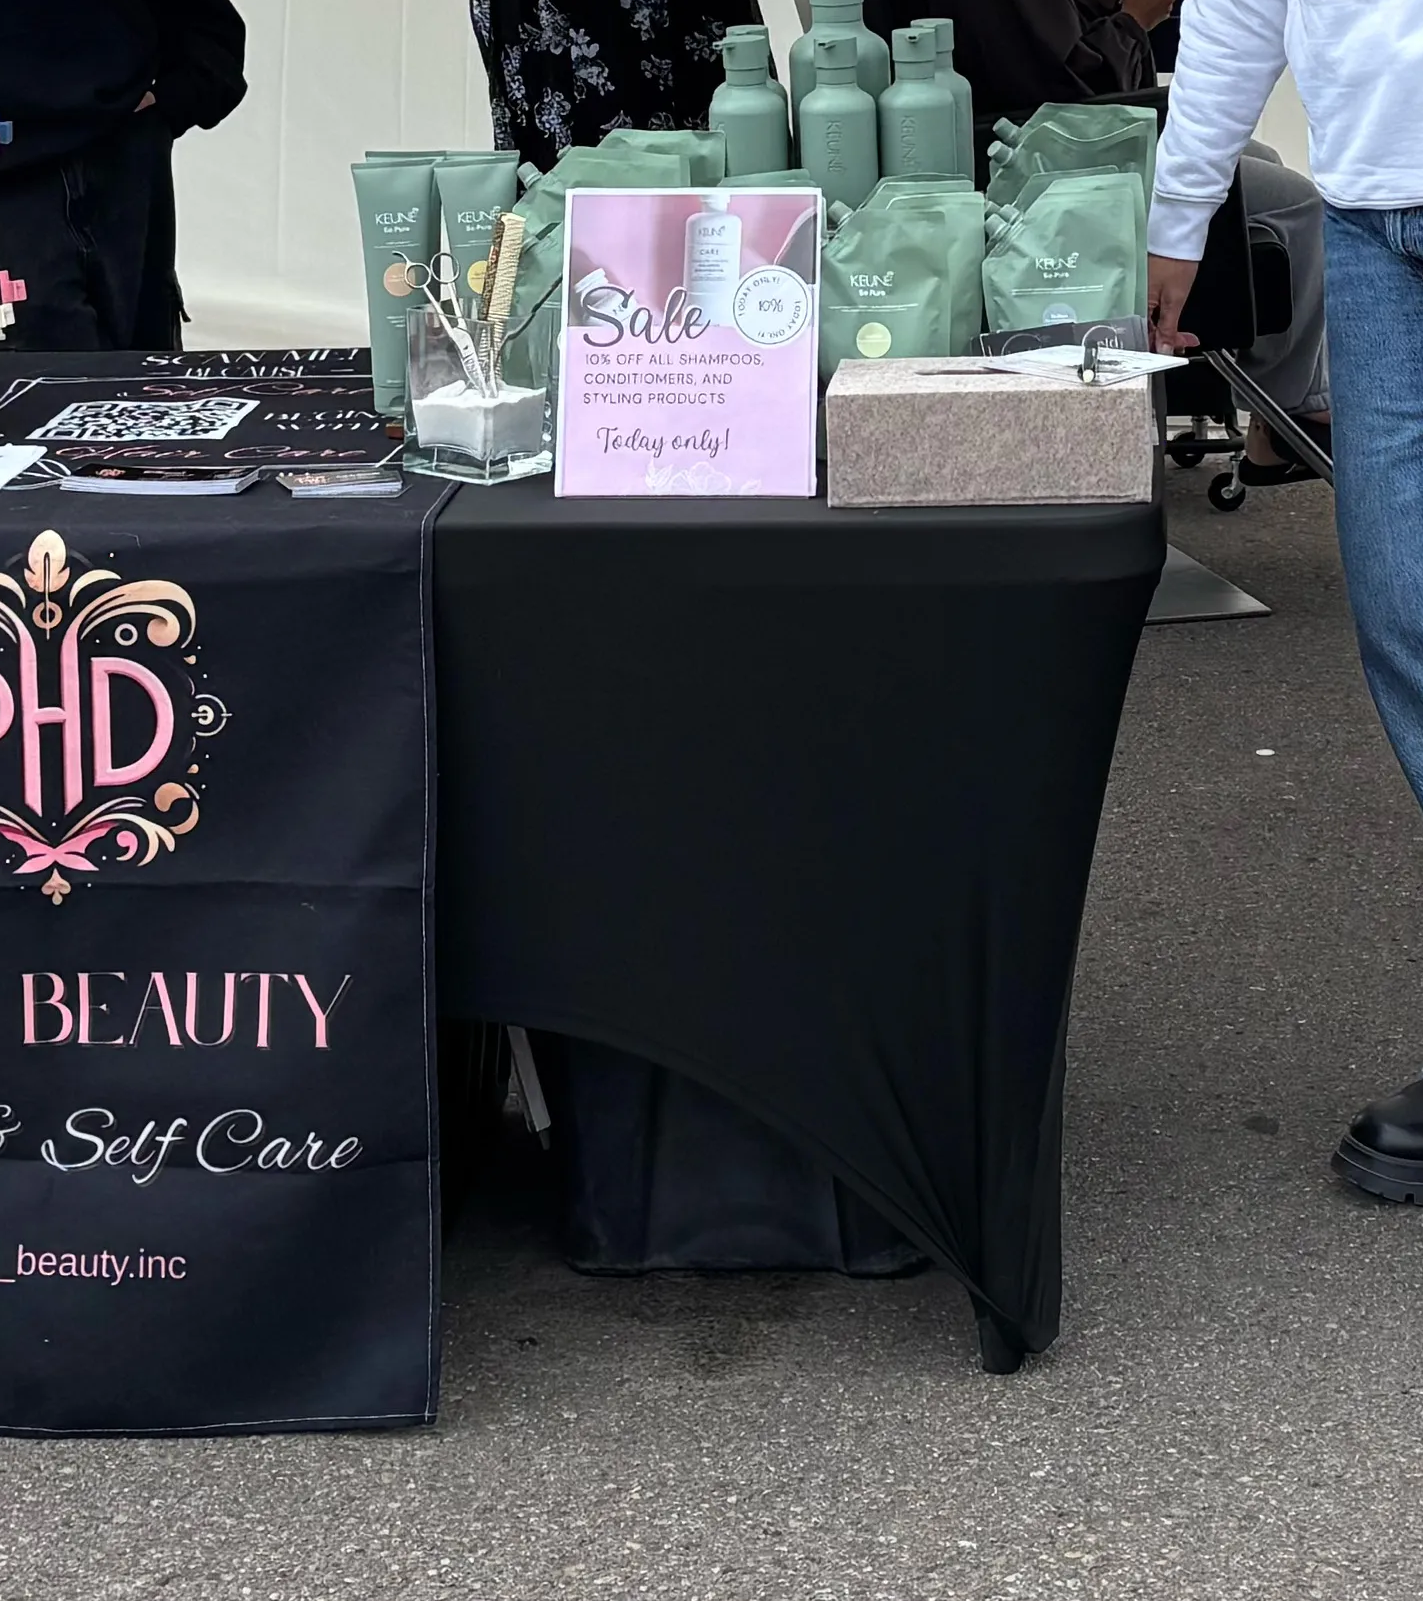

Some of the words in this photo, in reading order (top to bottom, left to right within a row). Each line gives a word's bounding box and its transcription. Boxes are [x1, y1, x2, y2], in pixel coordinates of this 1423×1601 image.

[375, 207, 419, 225] KEUNE
[1035, 251, 1079, 270] KEUNE
[849, 270, 894, 288] KEUNE
[581, 286, 711, 348] Sale
[585, 353, 611, 366] 10%
[616, 353, 643, 366] OFF
[649, 353, 674, 366] ALL
[679, 353, 765, 367] SHAMPOOS,
[583, 373, 698, 386] CONDITIONERS,
[702, 373, 733, 385] AND
[583, 392, 642, 405] STYLING
[648, 392, 726, 405] PRODUCTS
[596, 426, 667, 459] Today
[671, 427, 731, 459] only!
[19, 970, 353, 1051] BEAUTY
[40, 1106, 186, 1185] Self
[196, 1108, 364, 1175] Care
